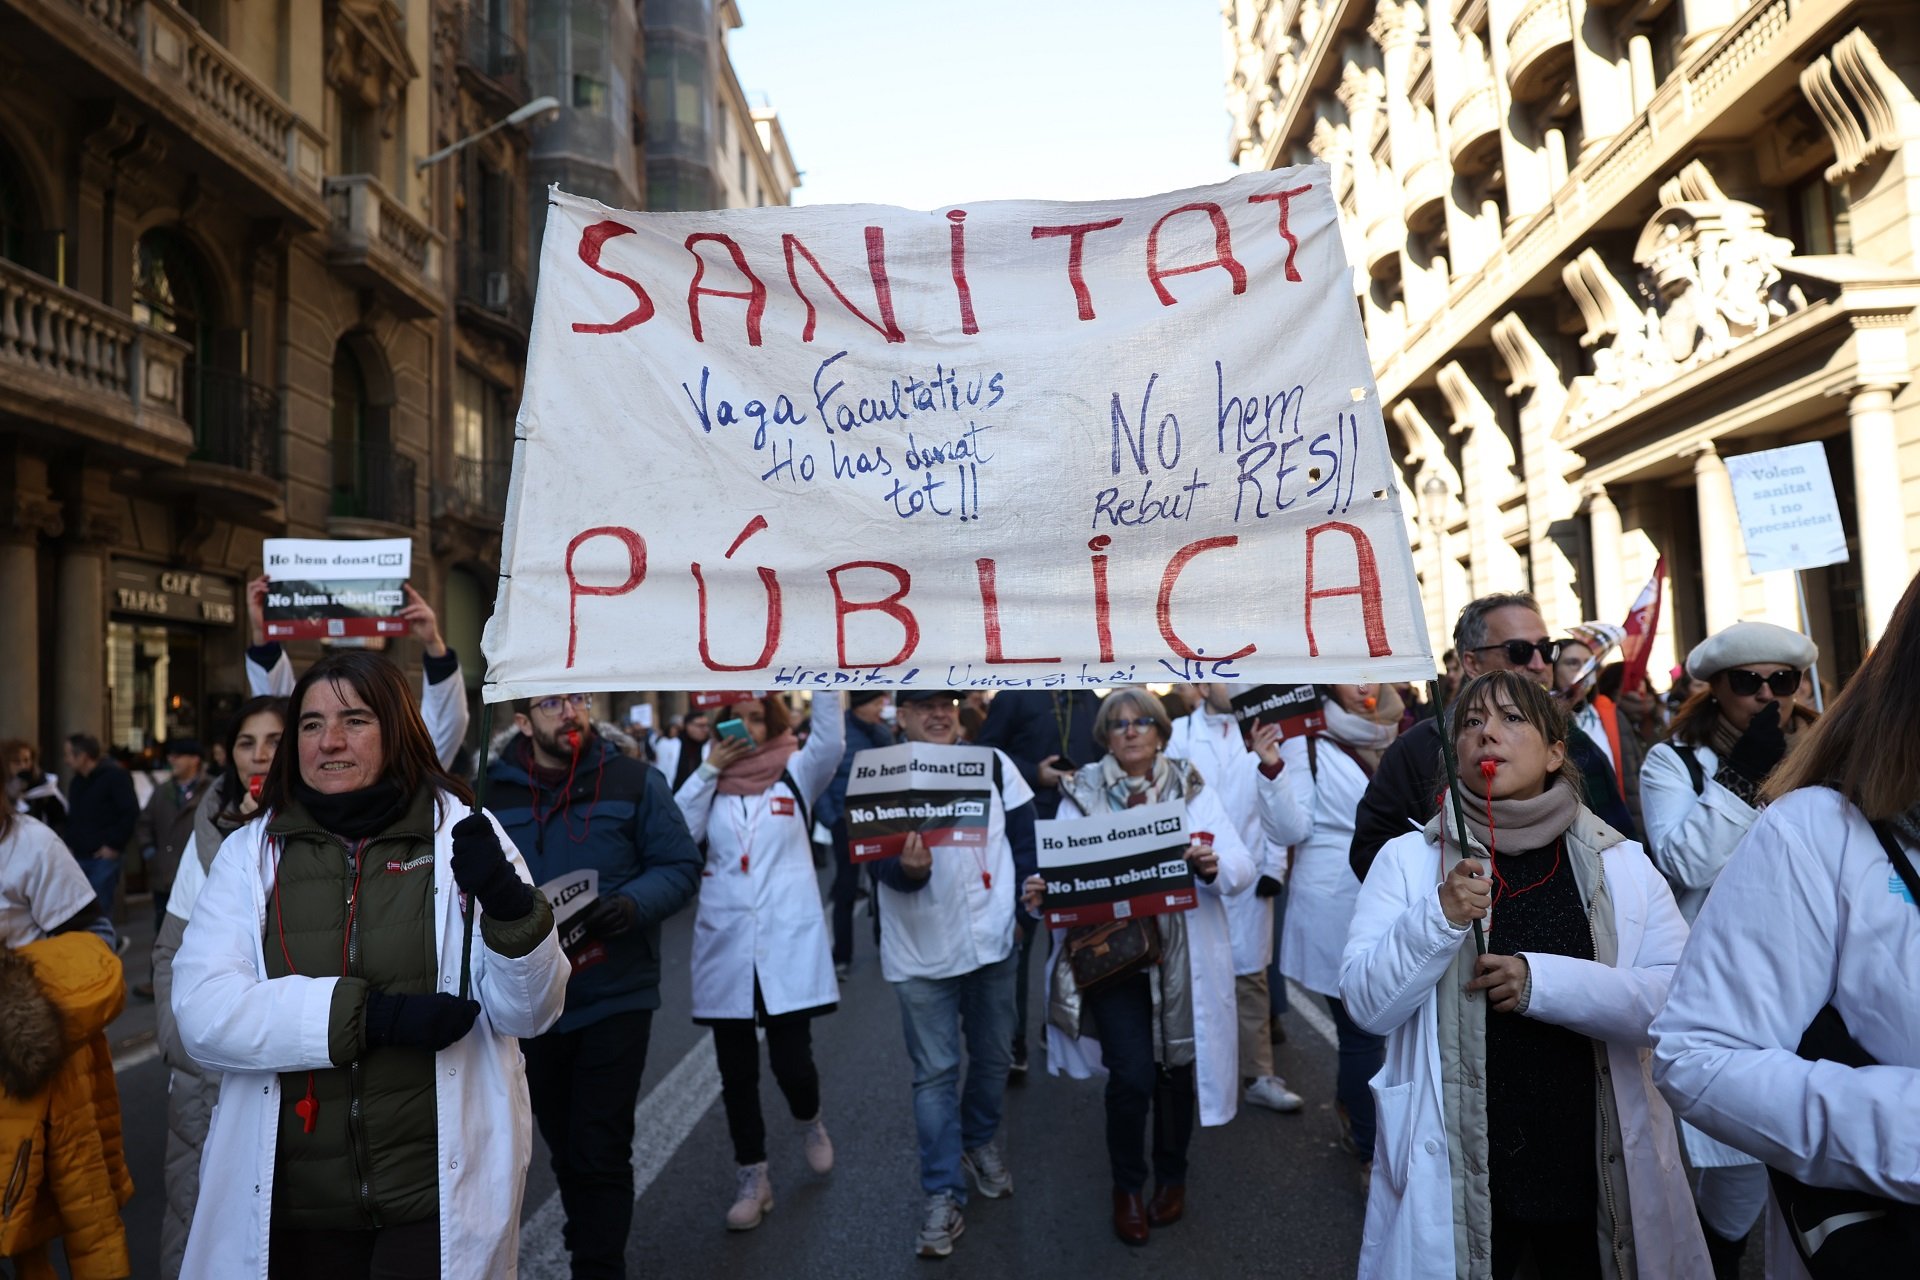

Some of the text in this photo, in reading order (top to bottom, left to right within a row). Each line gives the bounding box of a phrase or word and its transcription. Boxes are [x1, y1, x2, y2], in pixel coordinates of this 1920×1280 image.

[682, 350, 1005, 450] Vaga Facultatius
[1110, 360, 1304, 476] No hem
[761, 421, 996, 485] Ho has donat
[1751, 465, 1806, 480] Volem
[1092, 468, 1210, 529] Rebut
[1753, 481, 1813, 500] sanitat
[1781, 503, 1803, 514] no
[1748, 513, 1833, 538] precarietat
[294, 554, 328, 565] hem
[331, 554, 376, 565] donat
[118, 588, 168, 614] TAPAS
[268, 593, 291, 607] No
[294, 592, 329, 606] hem
[331, 591, 374, 605] rebut
[1262, 691, 1298, 710] rebut
[856, 759, 983, 779] Ho hem donat tot
[850, 803, 981, 824] No hem rebut res
[1042, 818, 1181, 850] Ho hem donat tot
[1047, 861, 1187, 895] No hem rebut res
